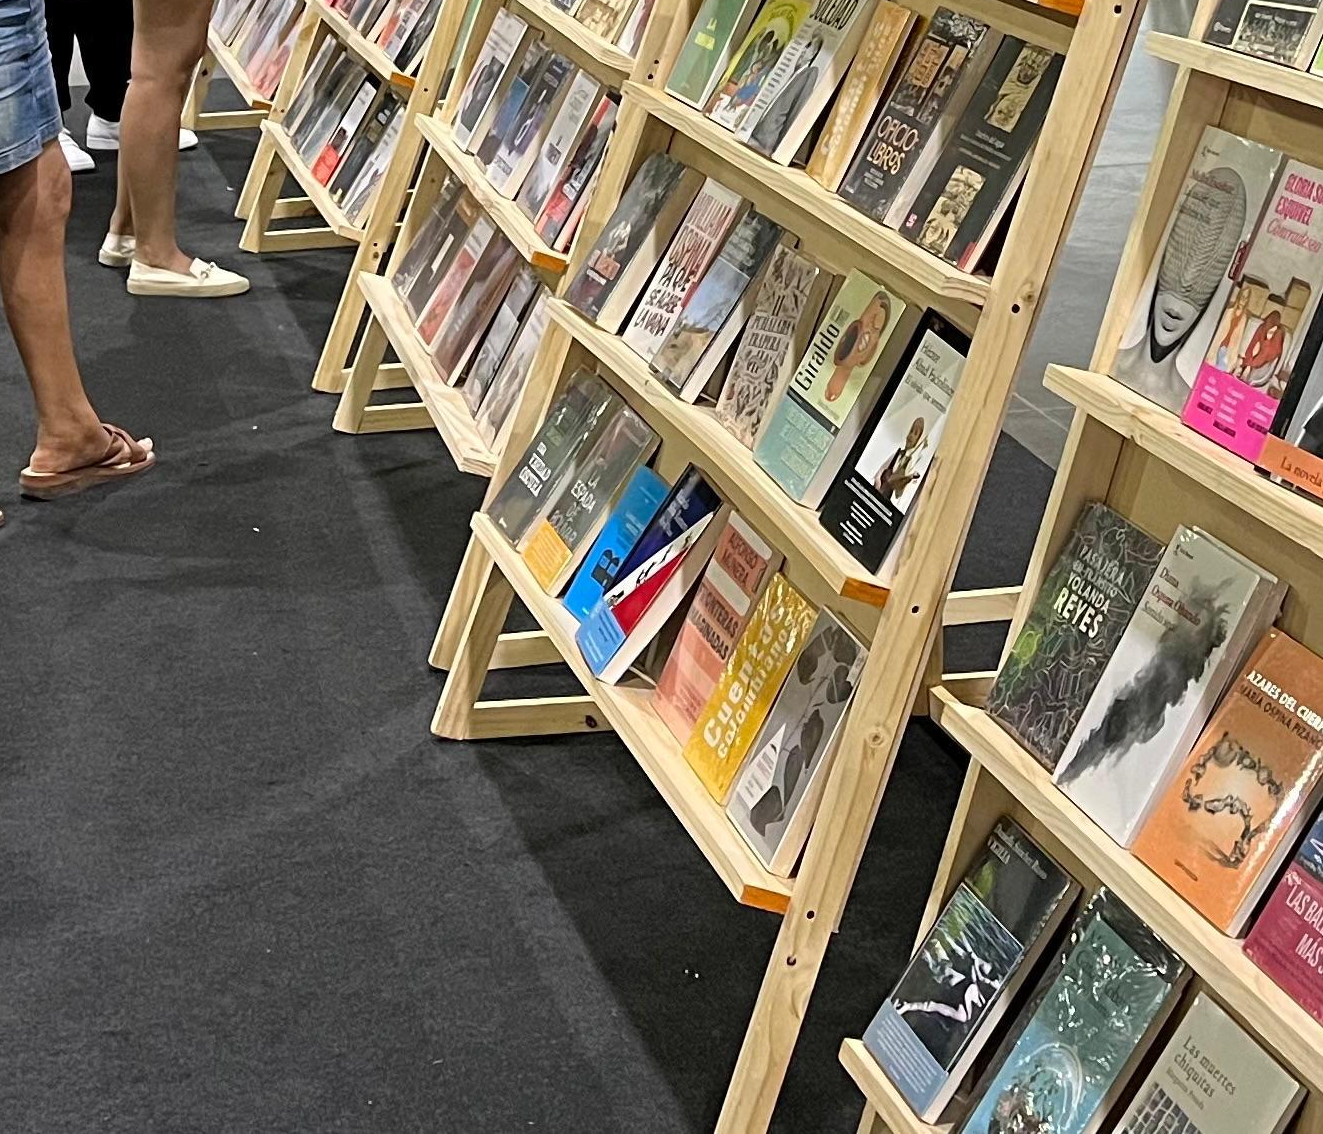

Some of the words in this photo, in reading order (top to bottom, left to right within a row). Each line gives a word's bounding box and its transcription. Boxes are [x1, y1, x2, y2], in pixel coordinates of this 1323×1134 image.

[867, 139, 906, 175] LIBROS
[794, 323, 841, 392] Giraldo
[1280, 456, 1292, 472] La
[1293, 464, 1322, 488] novela
[1053, 587, 1103, 639] REYES
[1067, 571, 1111, 615] YOLANDA
[1246, 670, 1282, 700] AZARES
[1278, 693, 1298, 713] DEL
[1264, 702, 1293, 730] OSPINA
[1291, 722, 1323, 749] PIZANO
[1285, 885, 1312, 914] LAS
[1174, 1053, 1215, 1098] chiquitas
[1182, 1035, 1201, 1059] Las
[1199, 1056, 1237, 1096] muertes
